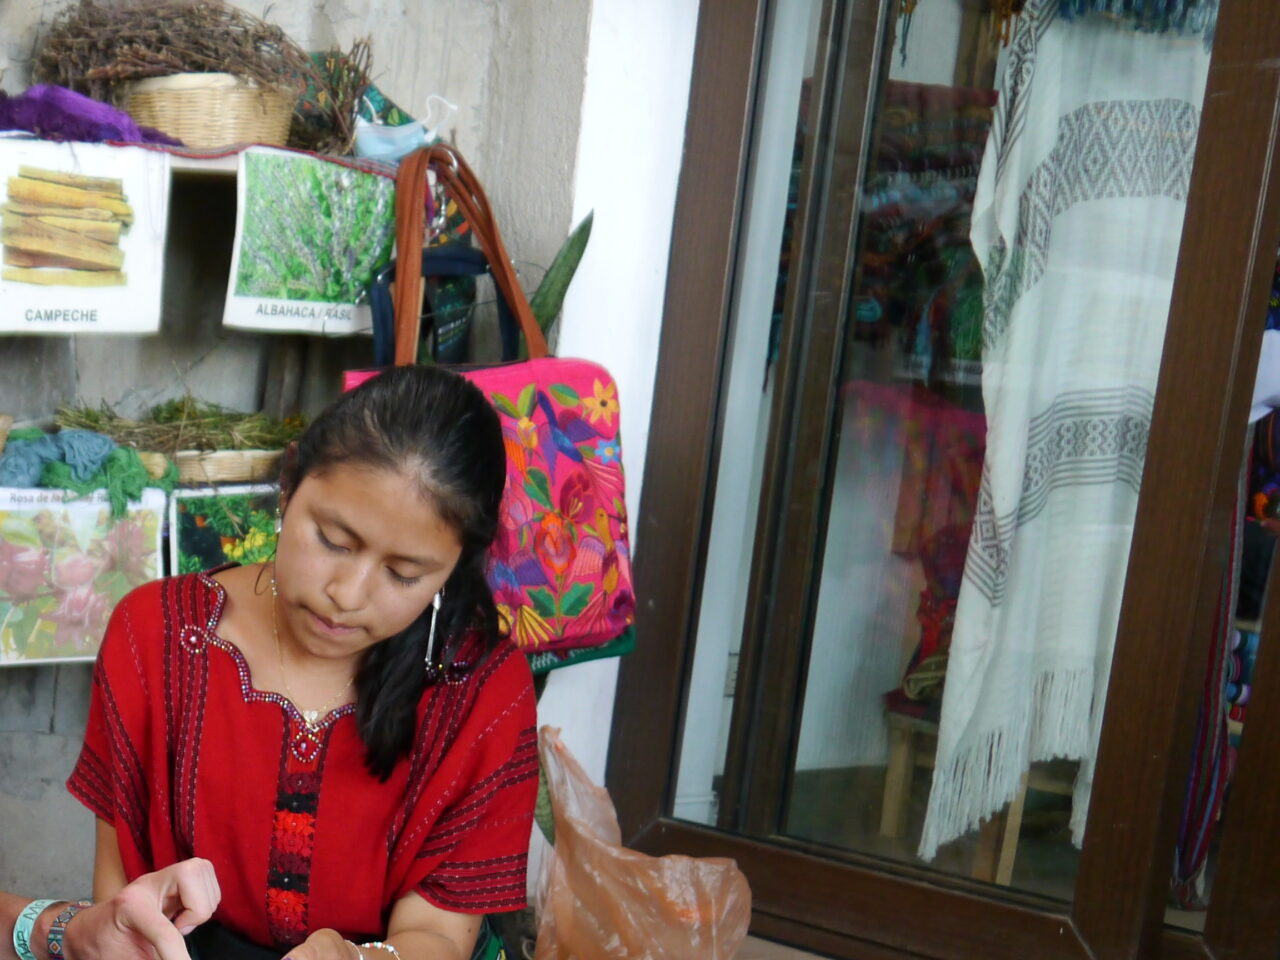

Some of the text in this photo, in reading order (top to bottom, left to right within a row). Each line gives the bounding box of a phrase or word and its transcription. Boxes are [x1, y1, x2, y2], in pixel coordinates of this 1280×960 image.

[24, 308, 99, 323] CAMPECHE
[255, 303, 316, 319] ALBAHACA
[9, 492, 34, 504] Rosa
